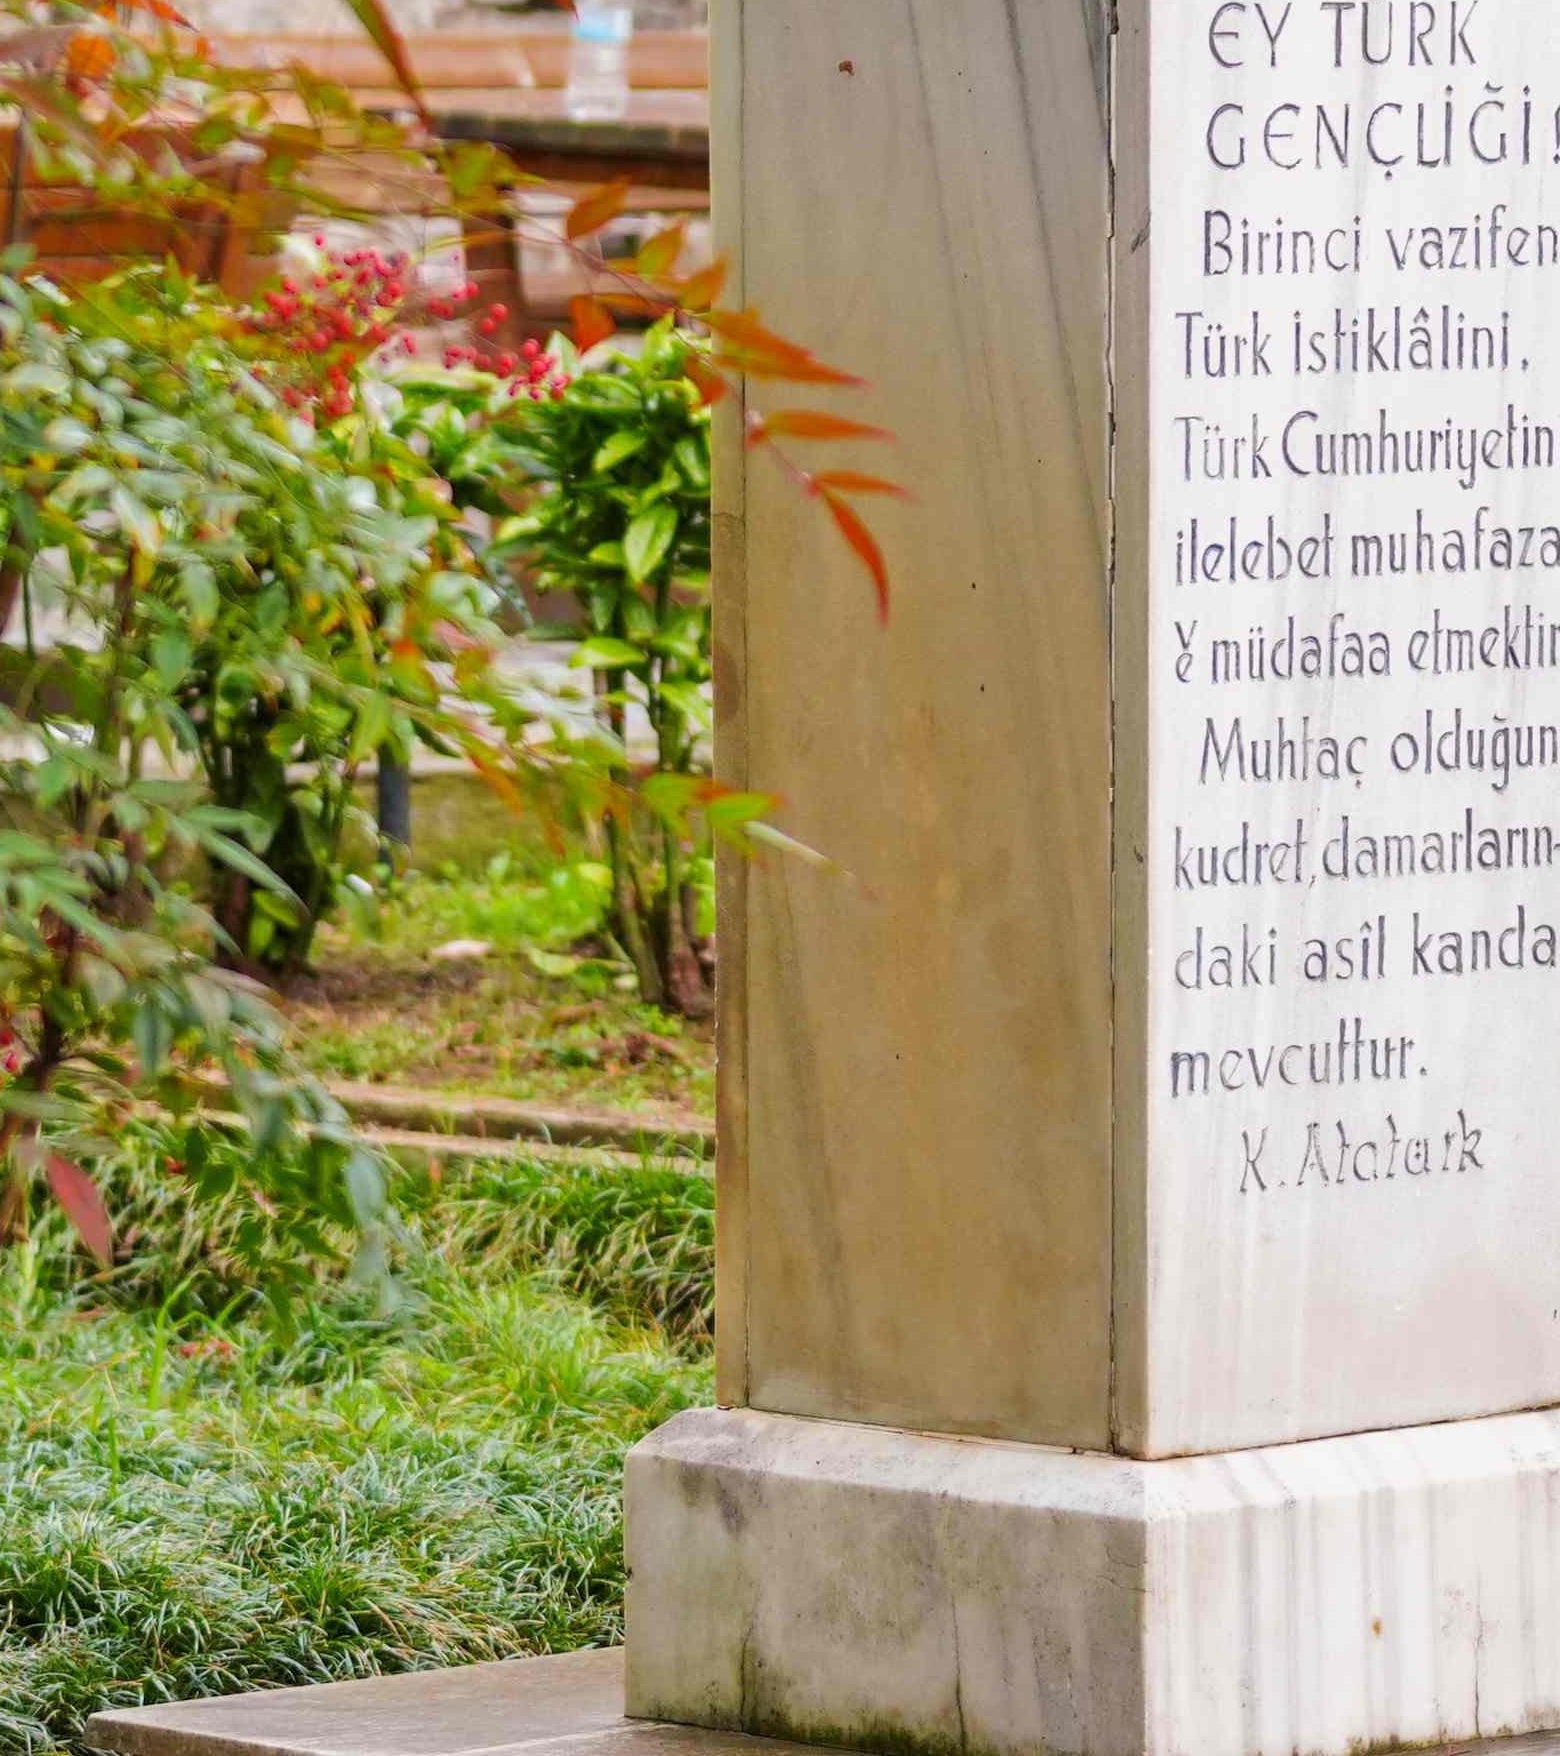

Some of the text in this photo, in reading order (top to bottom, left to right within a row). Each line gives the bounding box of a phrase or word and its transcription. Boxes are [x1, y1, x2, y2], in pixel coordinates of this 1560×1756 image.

[1208, 1, 1293, 69] EY
[1203, 210, 1363, 277] Birinci
[1175, 311, 1274, 380] Türk
[1175, 414, 1273, 481] Türk
[1175, 513, 1335, 586] ilelebet
[1211, 612, 1391, 684] müdafaa
[1199, 708, 1559, 792] Muhtaç olduğun
[1174, 923, 1277, 990] daki
[1412, 905, 1558, 976] kanda
[1170, 1017, 1429, 1099] mevcuttur.
